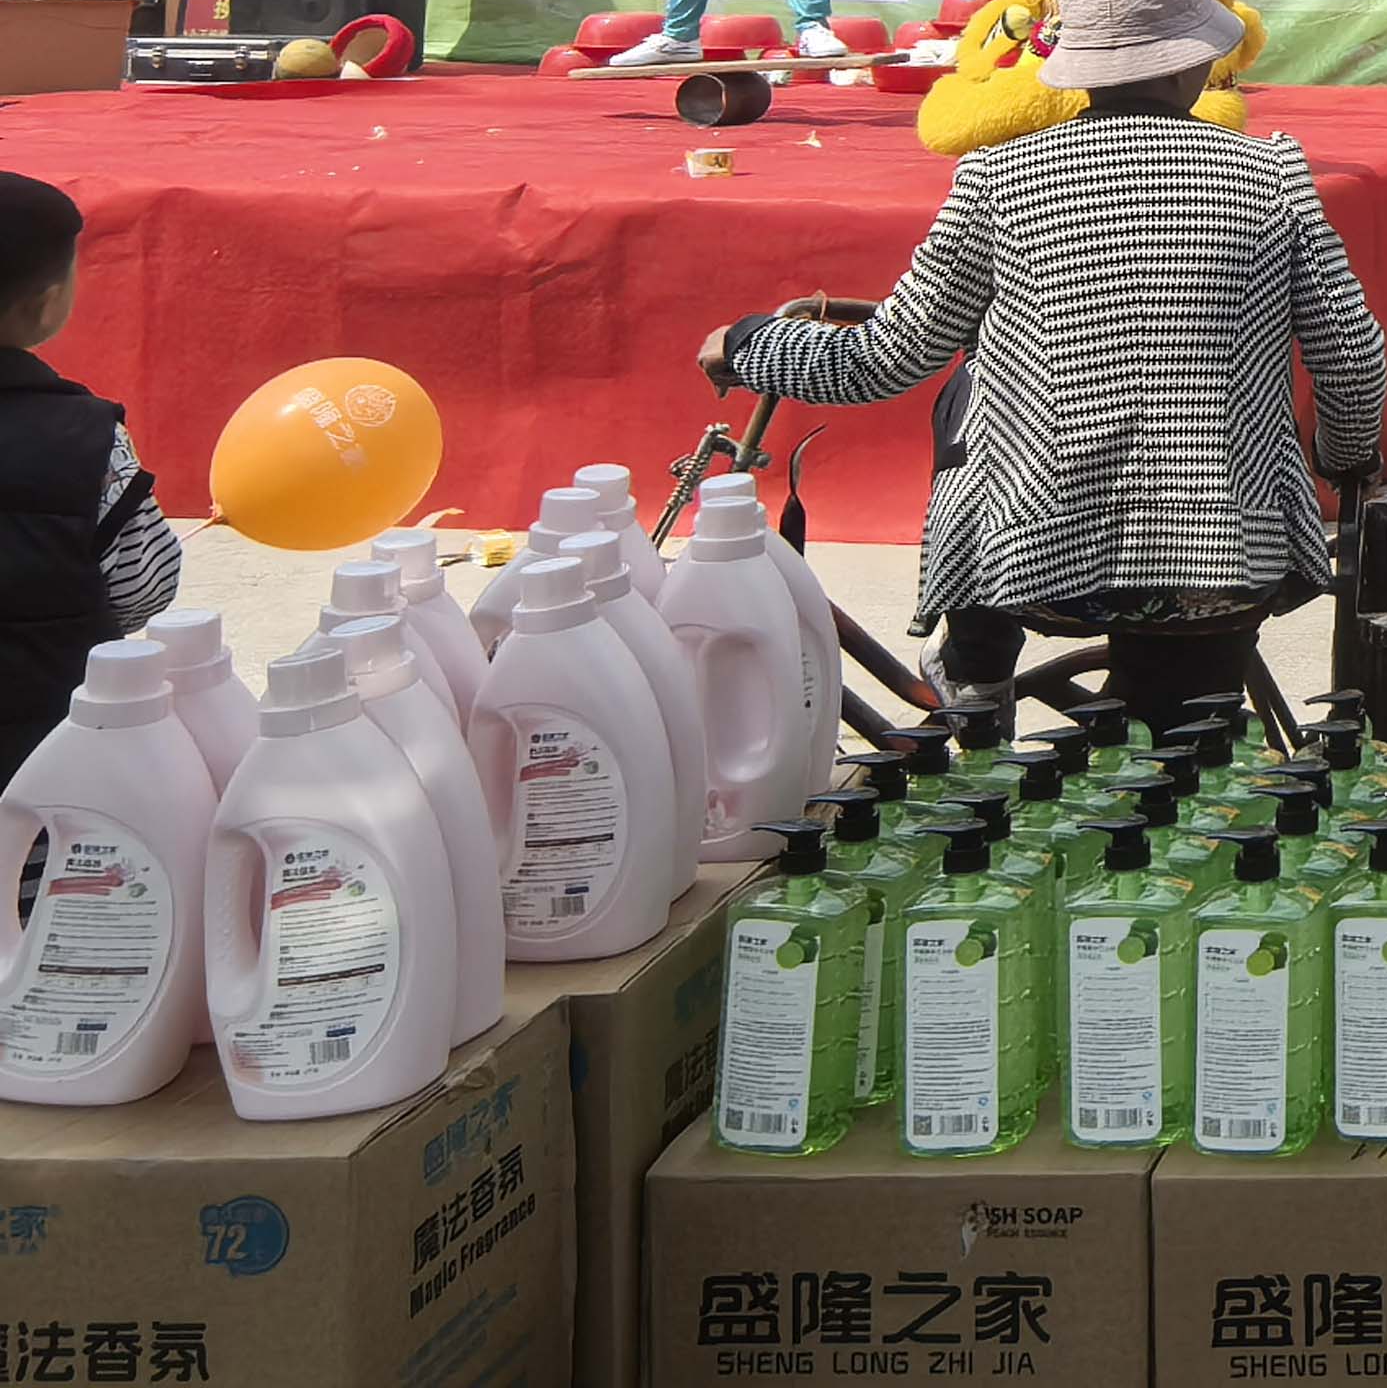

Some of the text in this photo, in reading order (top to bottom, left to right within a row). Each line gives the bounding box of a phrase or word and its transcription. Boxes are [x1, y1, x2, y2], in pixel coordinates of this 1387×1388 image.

[1022, 1206, 1084, 1225] SOAP
[698, 1271, 1052, 1347] 盛隆之家
[0, 1320, 210, 1382] 法香氛
[716, 1351, 1036, 1377] SHENG LONG ZHI JIA
[1230, 1351, 1328, 1380] SHENG
